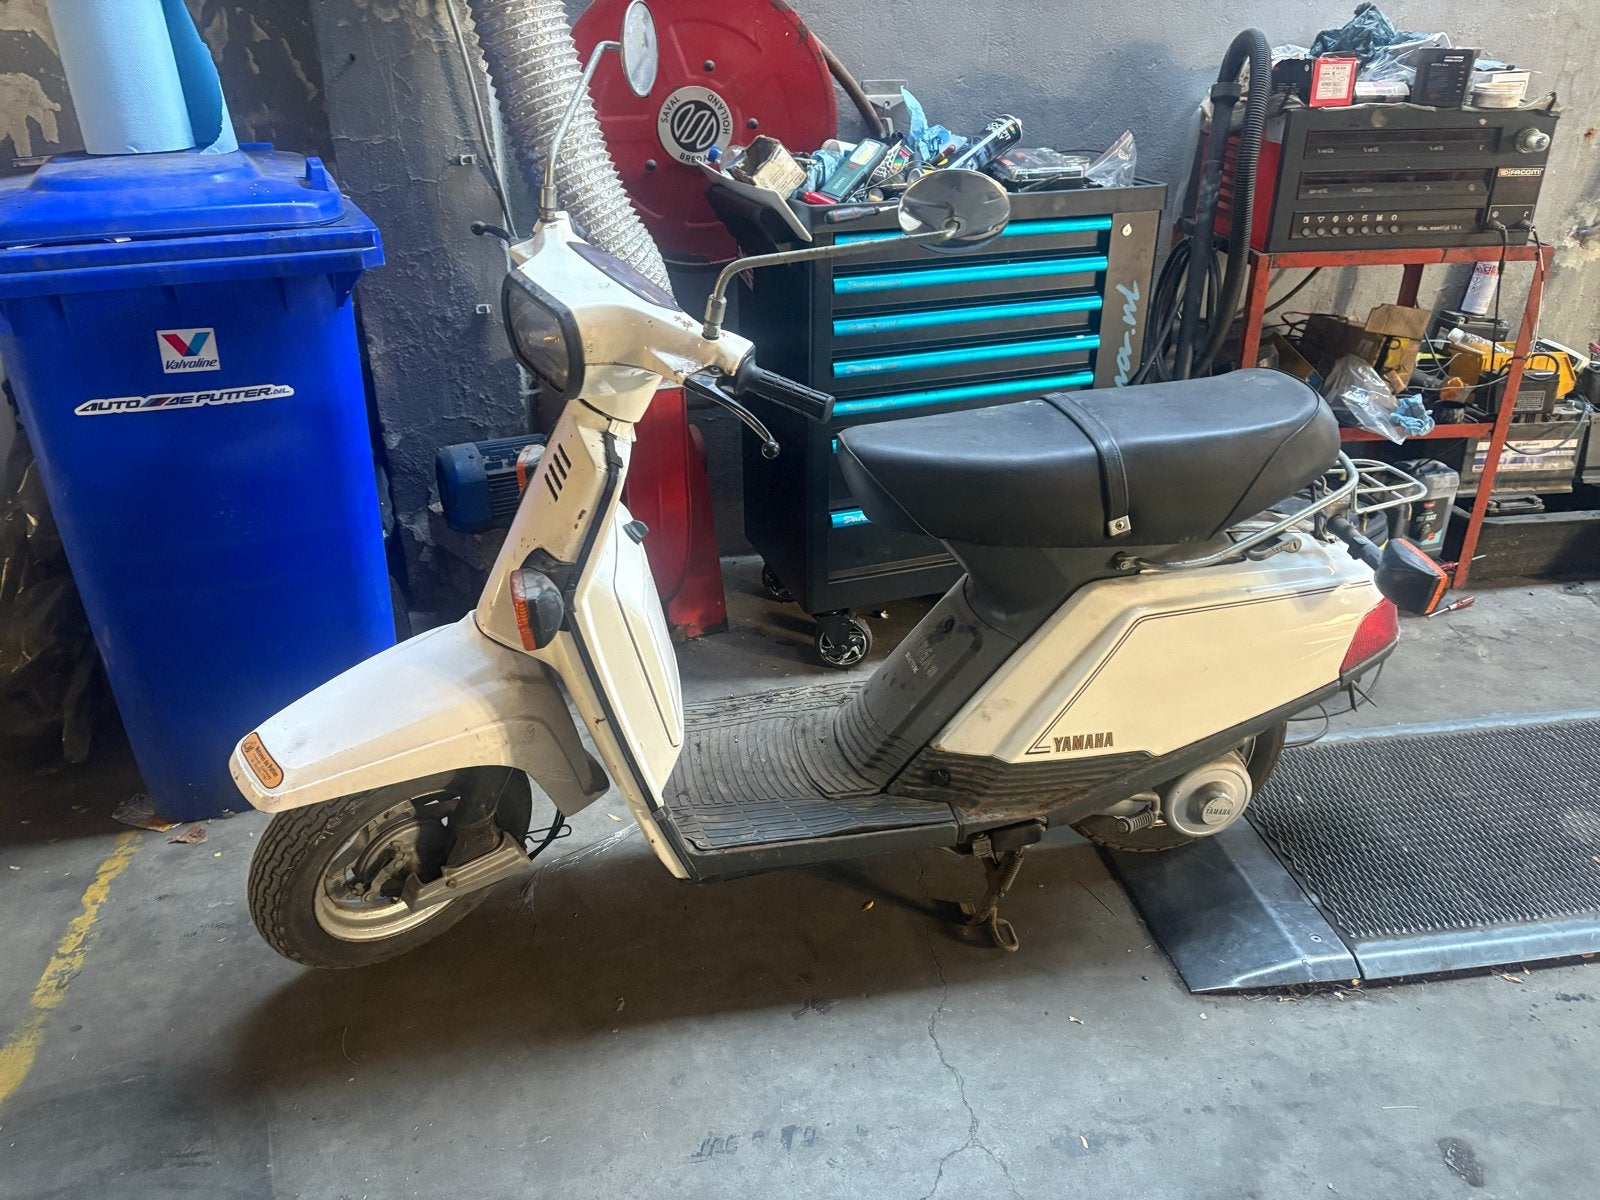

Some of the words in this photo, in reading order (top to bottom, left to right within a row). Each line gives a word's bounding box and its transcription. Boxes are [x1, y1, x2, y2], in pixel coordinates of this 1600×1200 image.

[660, 96, 681, 123] SAVAL
[707, 94, 730, 135] HOLLAND
[1510, 168, 1540, 176] FACOM
[165, 358, 218, 370] Valvoline
[78, 400, 141, 413] AUTO
[1054, 732, 1114, 752] YAMAHA
[1205, 807, 1232, 816] YAMAHA
